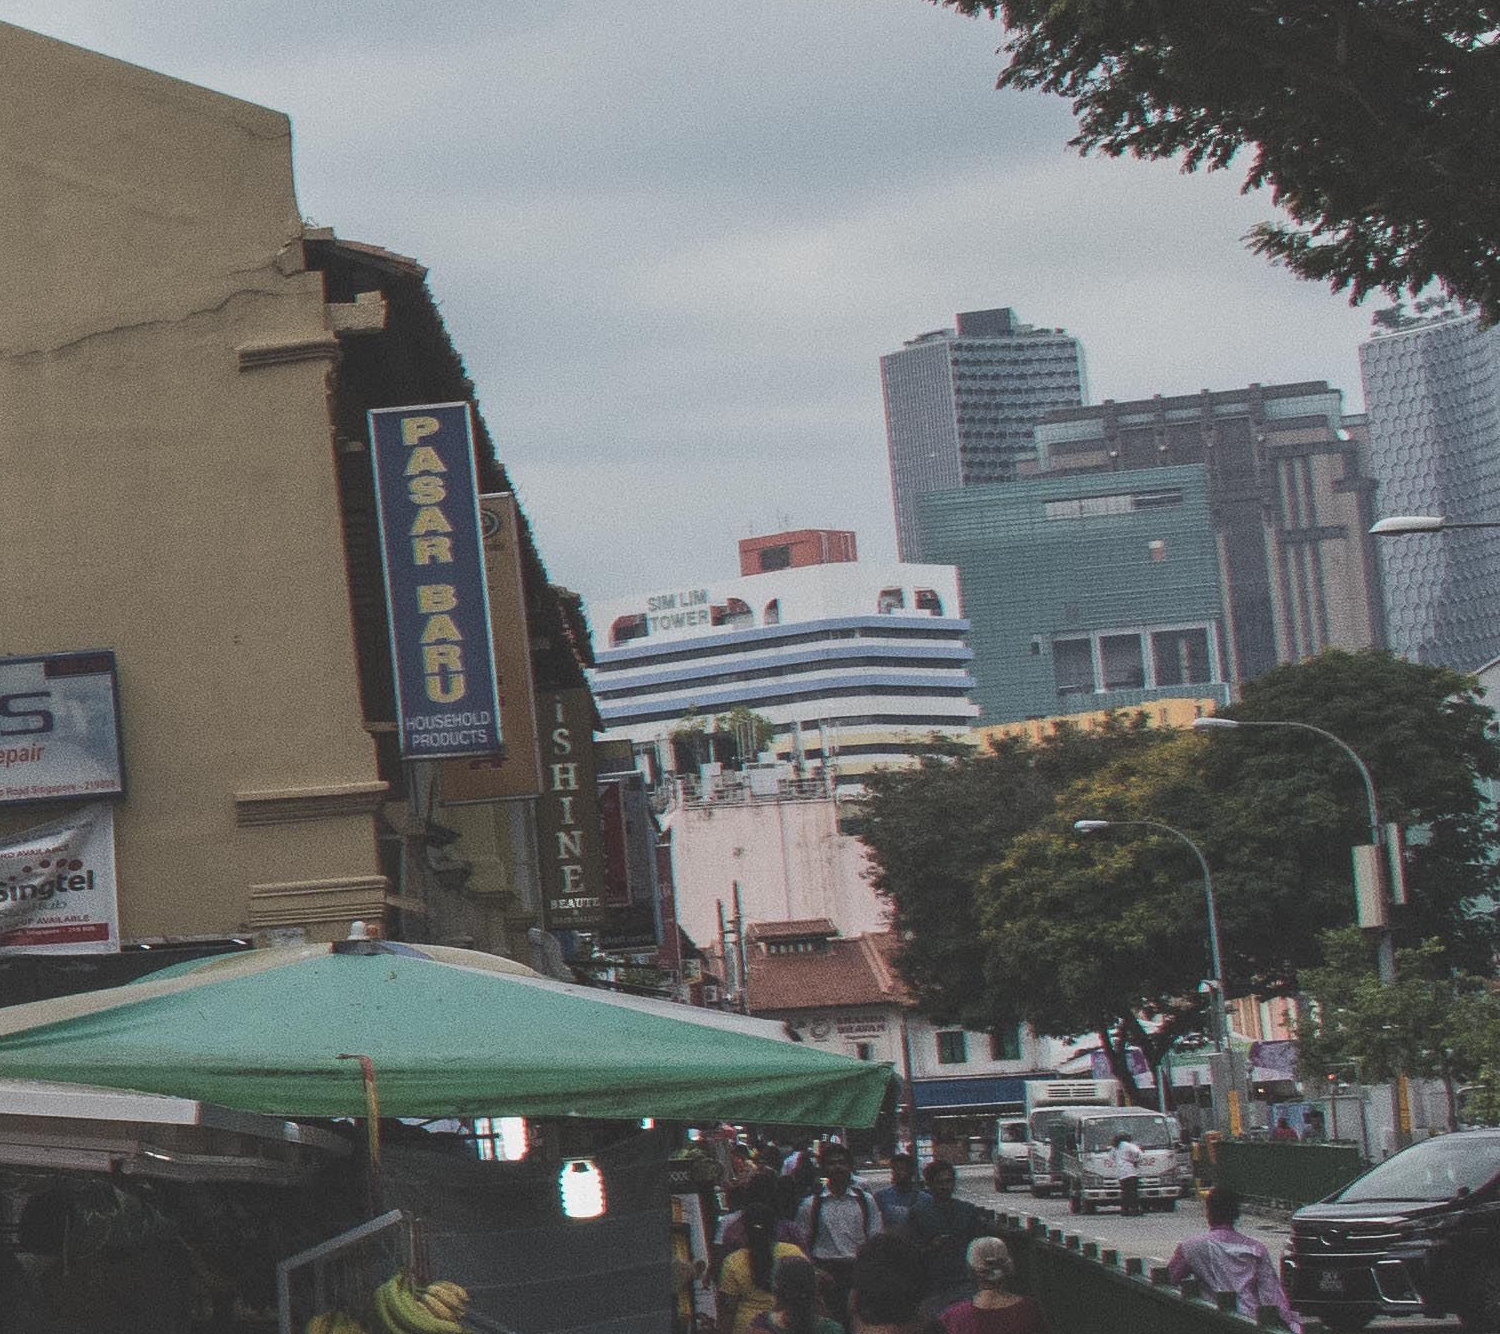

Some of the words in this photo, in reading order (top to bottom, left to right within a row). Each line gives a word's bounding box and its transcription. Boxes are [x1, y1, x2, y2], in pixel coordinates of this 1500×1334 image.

[401, 416, 454, 566] PASAR
[648, 593, 675, 612] SIM
[679, 588, 708, 608] LIM
[650, 609, 709, 632] TOWER
[416, 584, 467, 704] BARU
[406, 711, 490, 730] HOUSEHOLD
[412, 729, 488, 748] PRODUCTS
[6, 786, 29, 796] Road
[31, 784, 76, 795] Singapore
[36, 915, 90, 924] AVAILABLE
